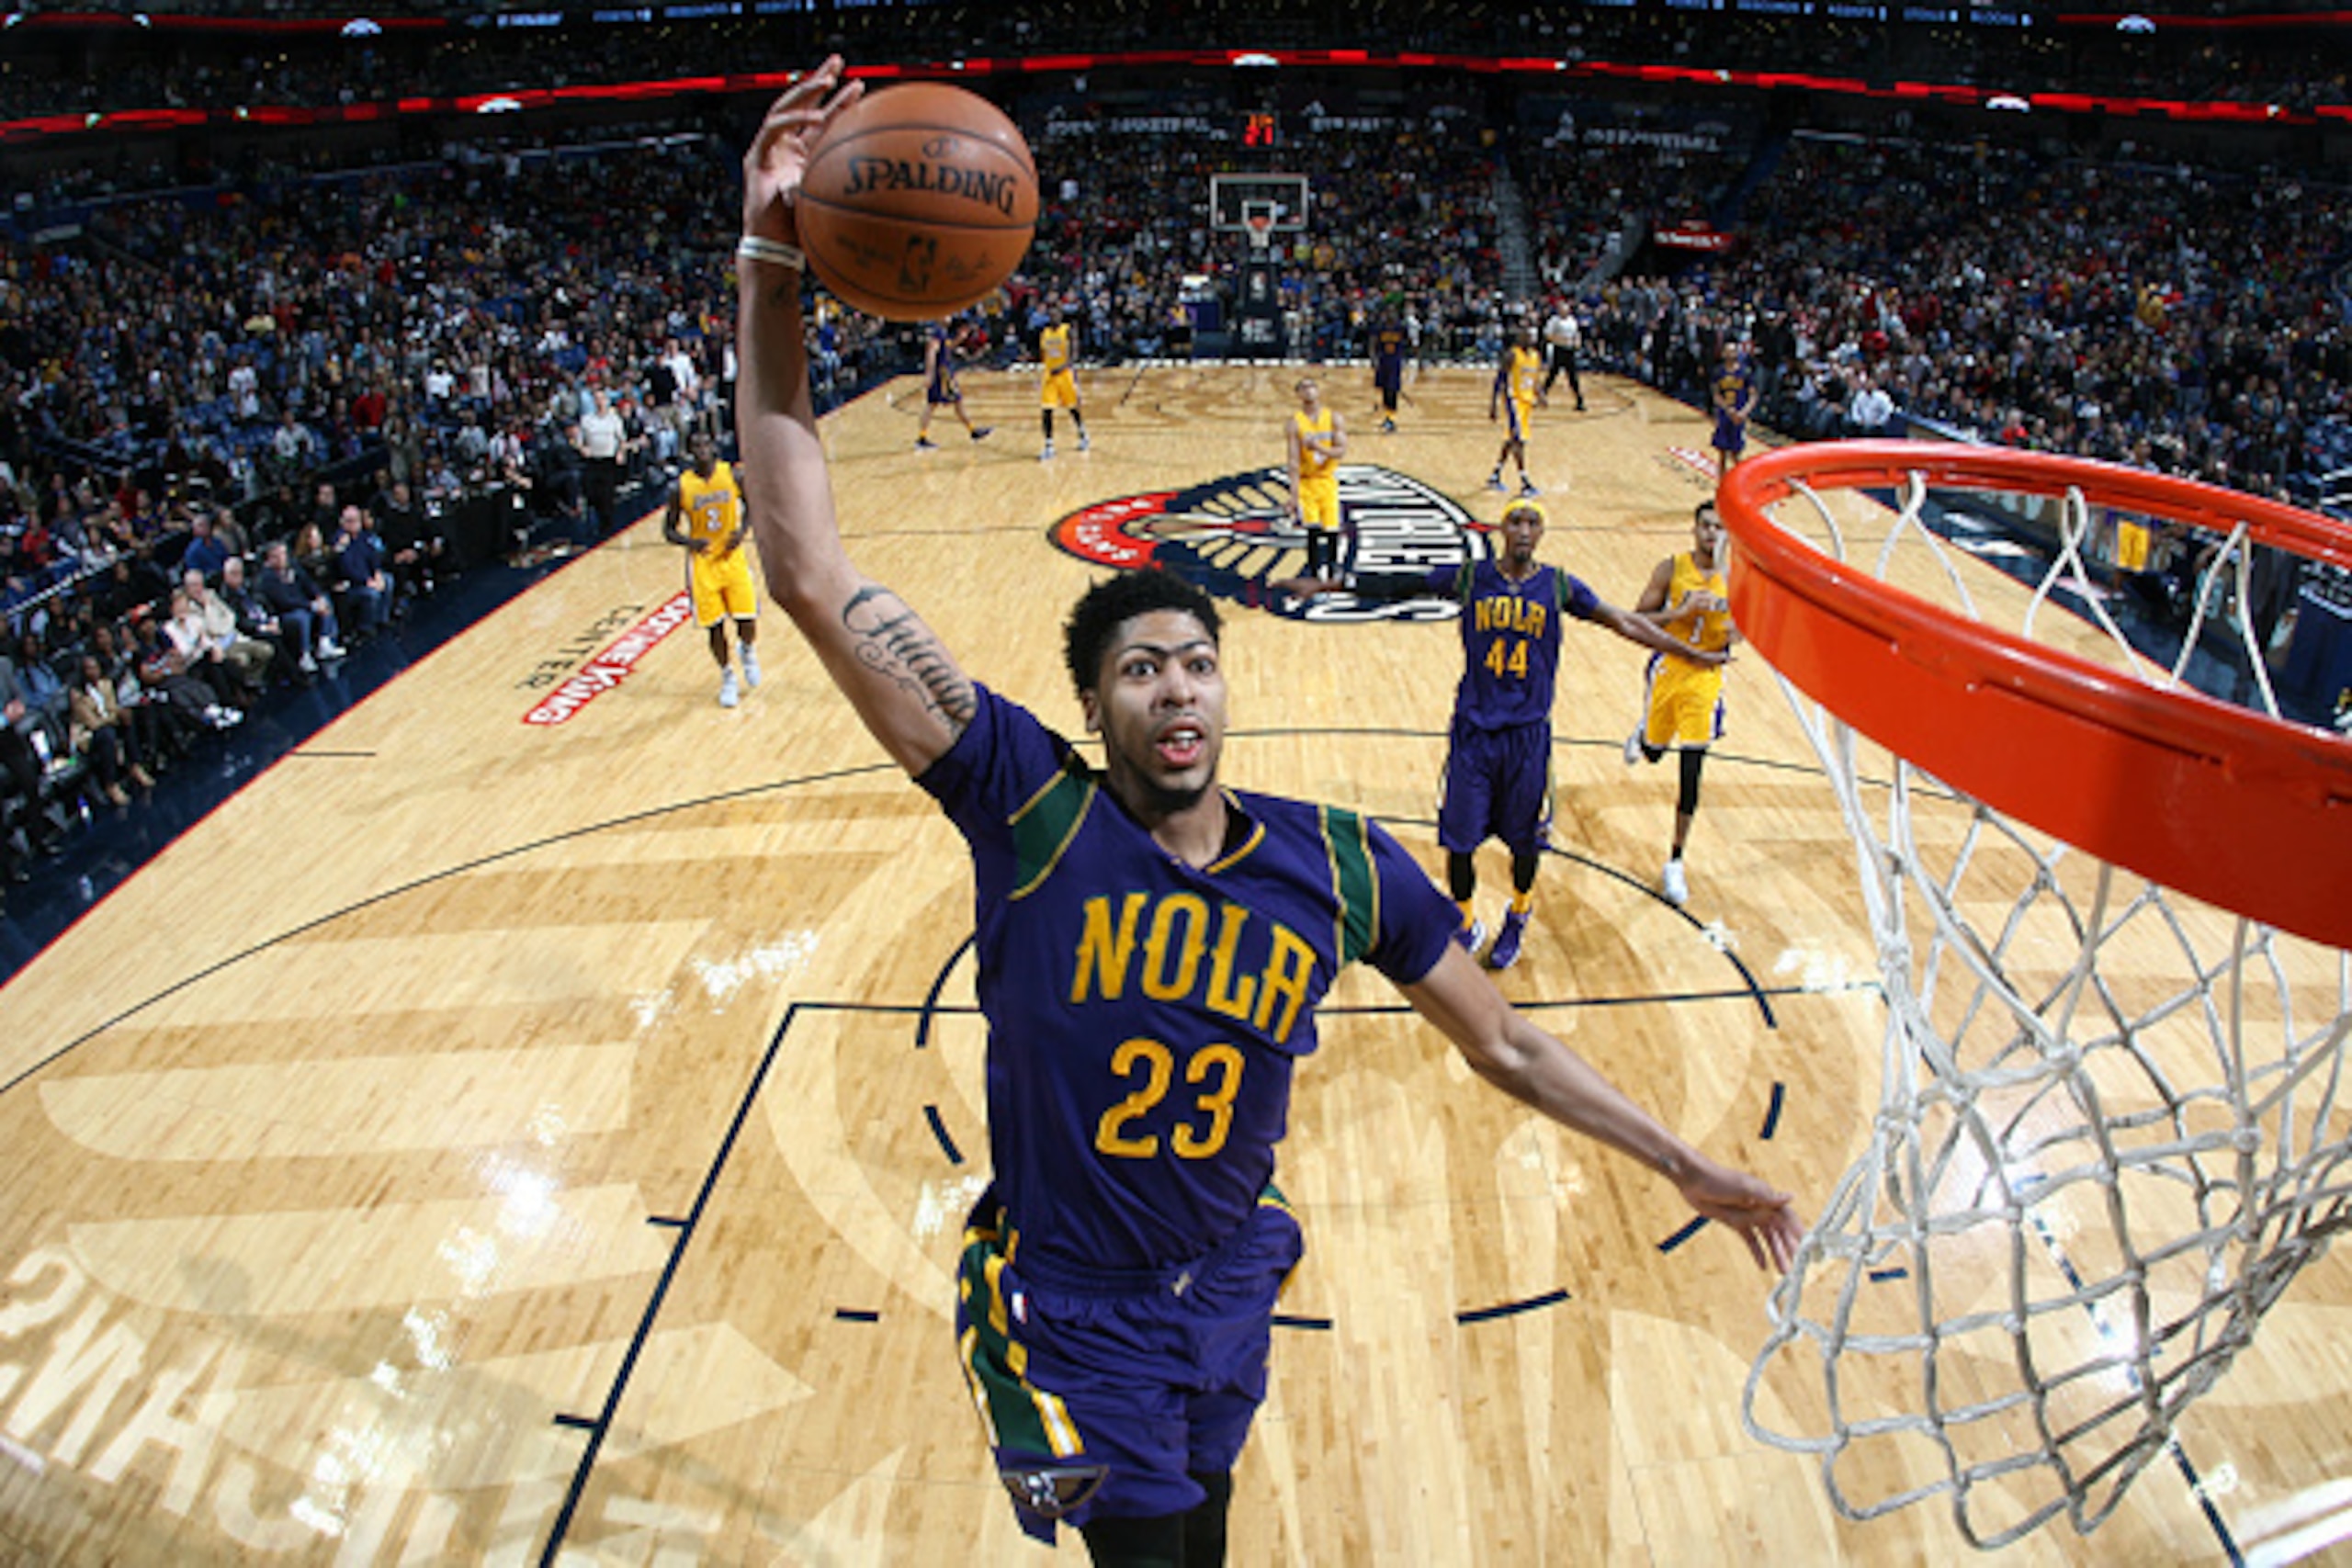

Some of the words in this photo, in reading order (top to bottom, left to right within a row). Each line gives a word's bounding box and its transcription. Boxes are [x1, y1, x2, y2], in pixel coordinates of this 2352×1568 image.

[844, 156, 1017, 217] SPALDING
[1475, 595, 1547, 640] NOLA
[1484, 638, 1529, 680] 44
[1070, 891, 1317, 1043] NOLA
[1094, 1037, 1245, 1158] 23
